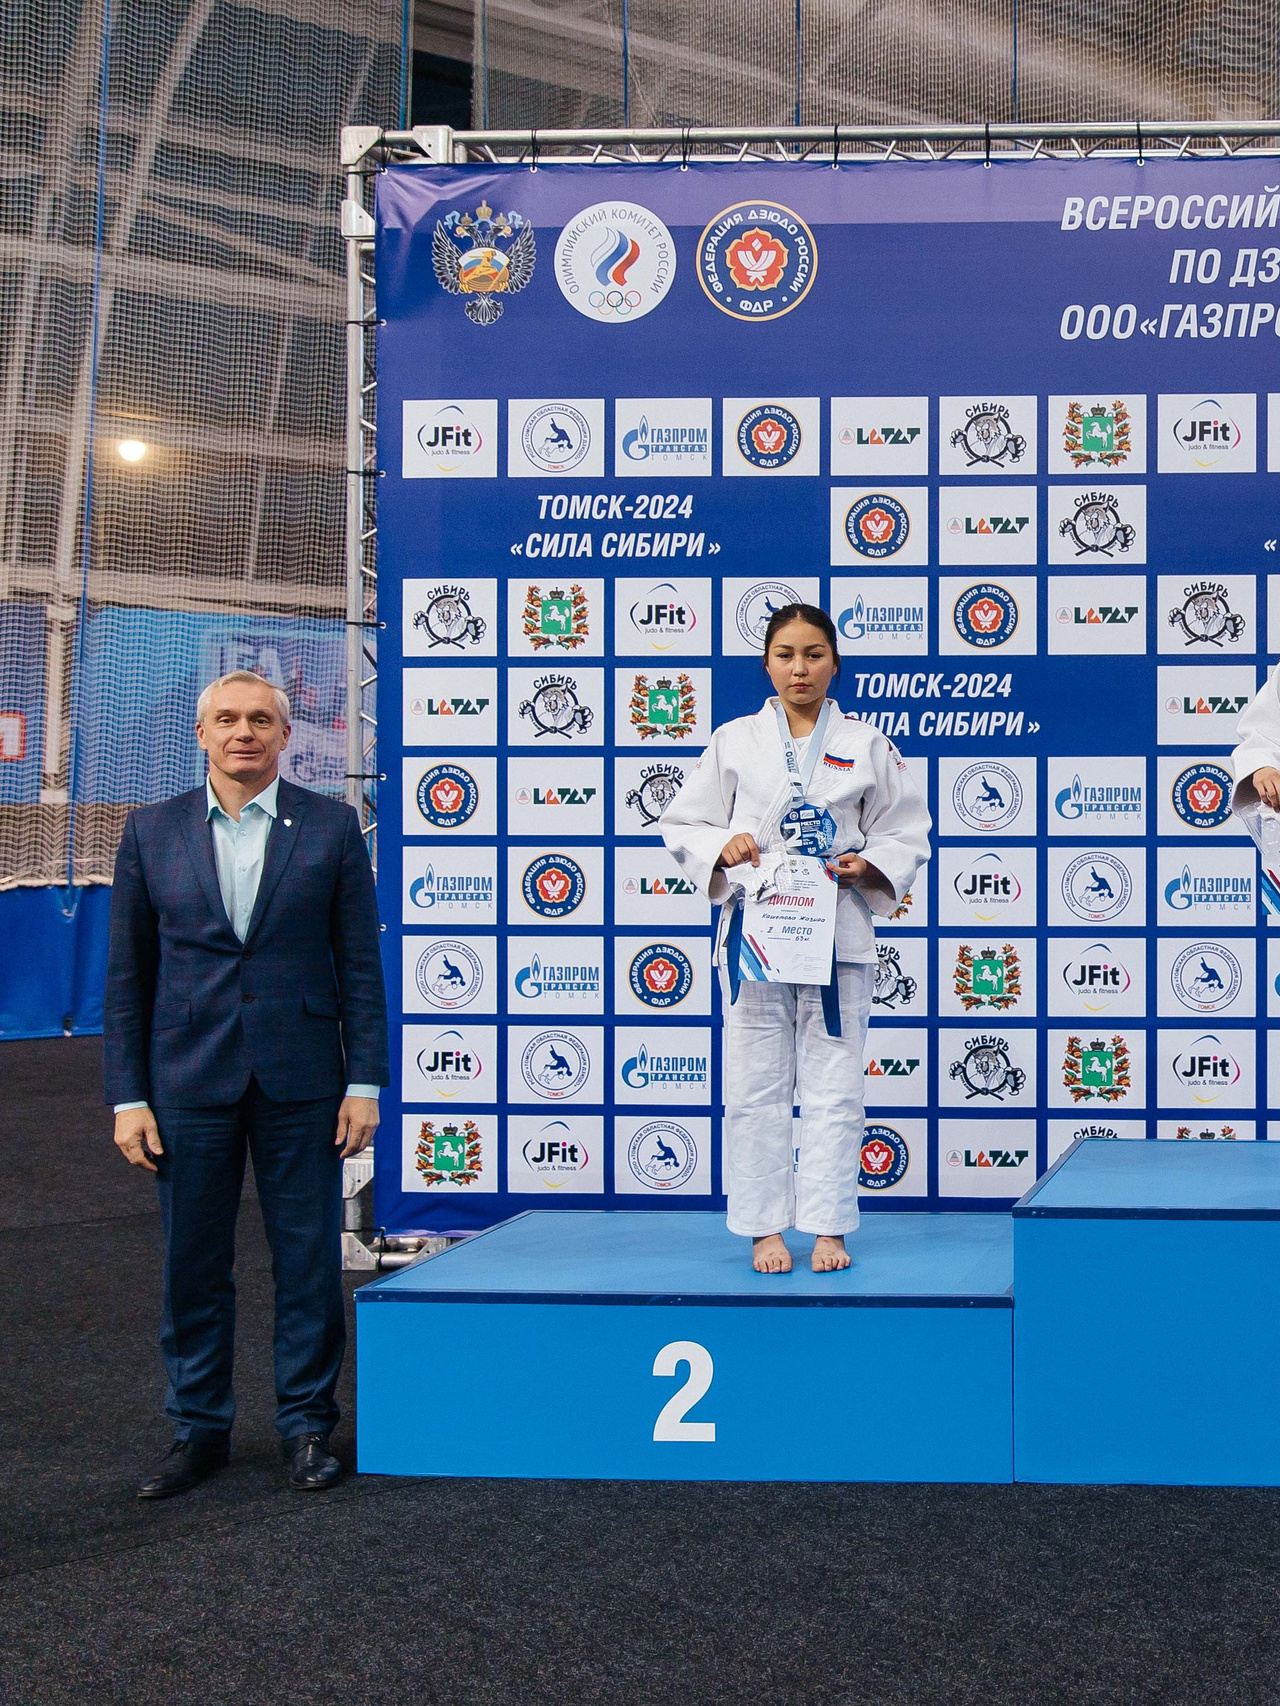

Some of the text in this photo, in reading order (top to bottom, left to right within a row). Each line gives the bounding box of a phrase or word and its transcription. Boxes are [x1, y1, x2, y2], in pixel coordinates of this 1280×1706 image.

[561, 208, 669, 294] ОЛИМПИЙСКИЙ КОМИТЕТ РОССИИ
[704, 208, 809, 293] ФЕДЕРАЦИЯ ДЗЮДО РОССИИ
[1168, 248, 1222, 285] ПО
[739, 299, 774, 313] ФДР
[965, 402, 1009, 418] СИБИРЬ
[425, 426, 472, 447] JFit
[651, 428, 707, 442] ГАЗПРОМ
[739, 409, 761, 455] ФЕДЕРАЦИЯ
[787, 423, 799, 455] РОССИИ
[1182, 420, 1229, 441] JFit
[1188, 443, 1201, 451] judo
[759, 458, 778, 466] ФДР
[538, 494, 693, 520] ТОМСК-2024
[1073, 492, 1118, 508] СИБИРЬ
[510, 532, 593, 558] «СИЛА
[427, 585, 470, 601] СИБИРЬ
[1183, 582, 1228, 598] СИБИРЬ
[638, 604, 685, 625] JFit
[866, 607, 923, 621] ГАЗПРОМ
[866, 623, 922, 631] ТРАНСГАЗ
[533, 674, 577, 690] СИБИРЬ
[855, 673, 1012, 698] ТОМСК-2024
[823, 761, 851, 772] RUSSIA
[1084, 787, 1141, 801] ГАЗПРОМ
[1084, 803, 1140, 811] ТРАНСГАЗ
[437, 876, 492, 890] ГАЗПРОМ
[962, 873, 1010, 894] JFit
[1193, 878, 1251, 892] ГАЗПРОМ
[437, 892, 492, 900] ТРАНСГАЗ
[767, 895, 814, 907] ДИПЛОМ
[1194, 894, 1250, 902] ТРАНСГАЗ
[543, 966, 598, 980] ГАЗПРОМ
[1072, 964, 1119, 985] JFit
[543, 982, 598, 990] ТРАНСГАЗ
[964, 1035, 1009, 1051] СИБИРЬ
[425, 1051, 471, 1072] JFit
[650, 1056, 706, 1070] ГАЗПРОМ
[1181, 1056, 1229, 1077] JFit
[531, 1141, 578, 1162] JFit
[653, 1341, 716, 1442] 2
